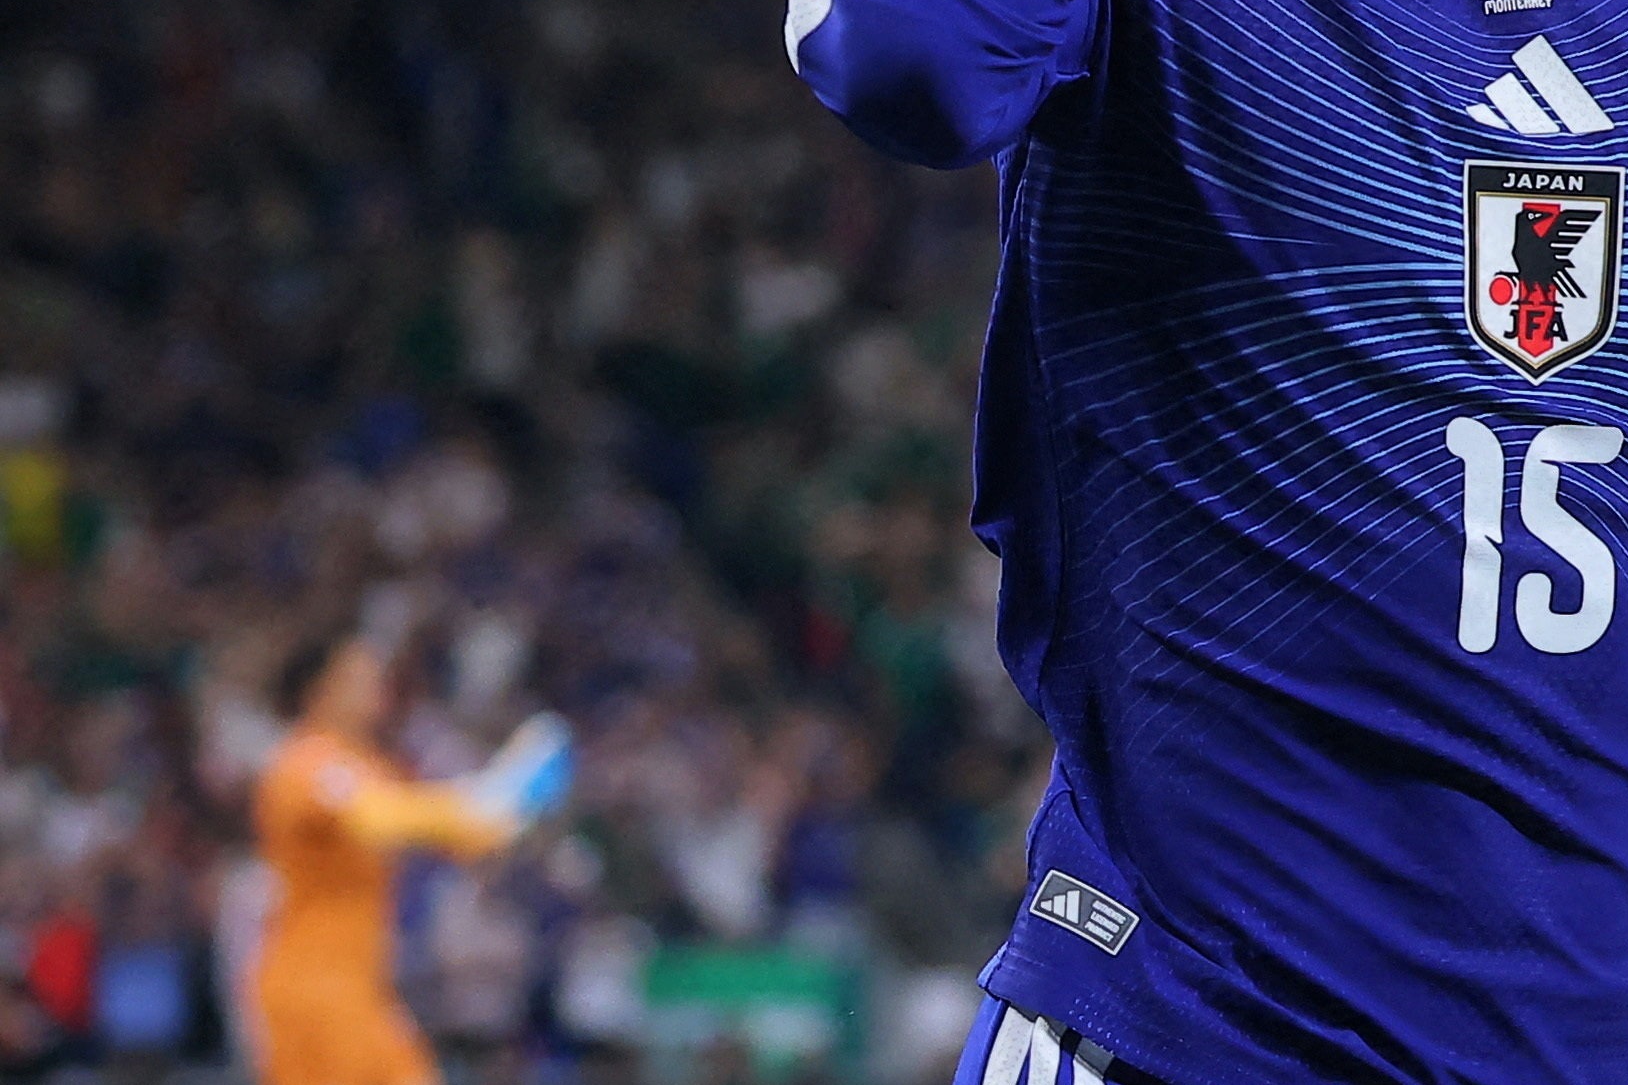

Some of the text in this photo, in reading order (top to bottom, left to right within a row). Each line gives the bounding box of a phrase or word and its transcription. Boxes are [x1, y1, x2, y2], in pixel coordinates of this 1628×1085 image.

[1503, 173, 1584, 191] JAPAN
[1503, 310, 1569, 342] JFA
[1446, 417, 1624, 654] 15
